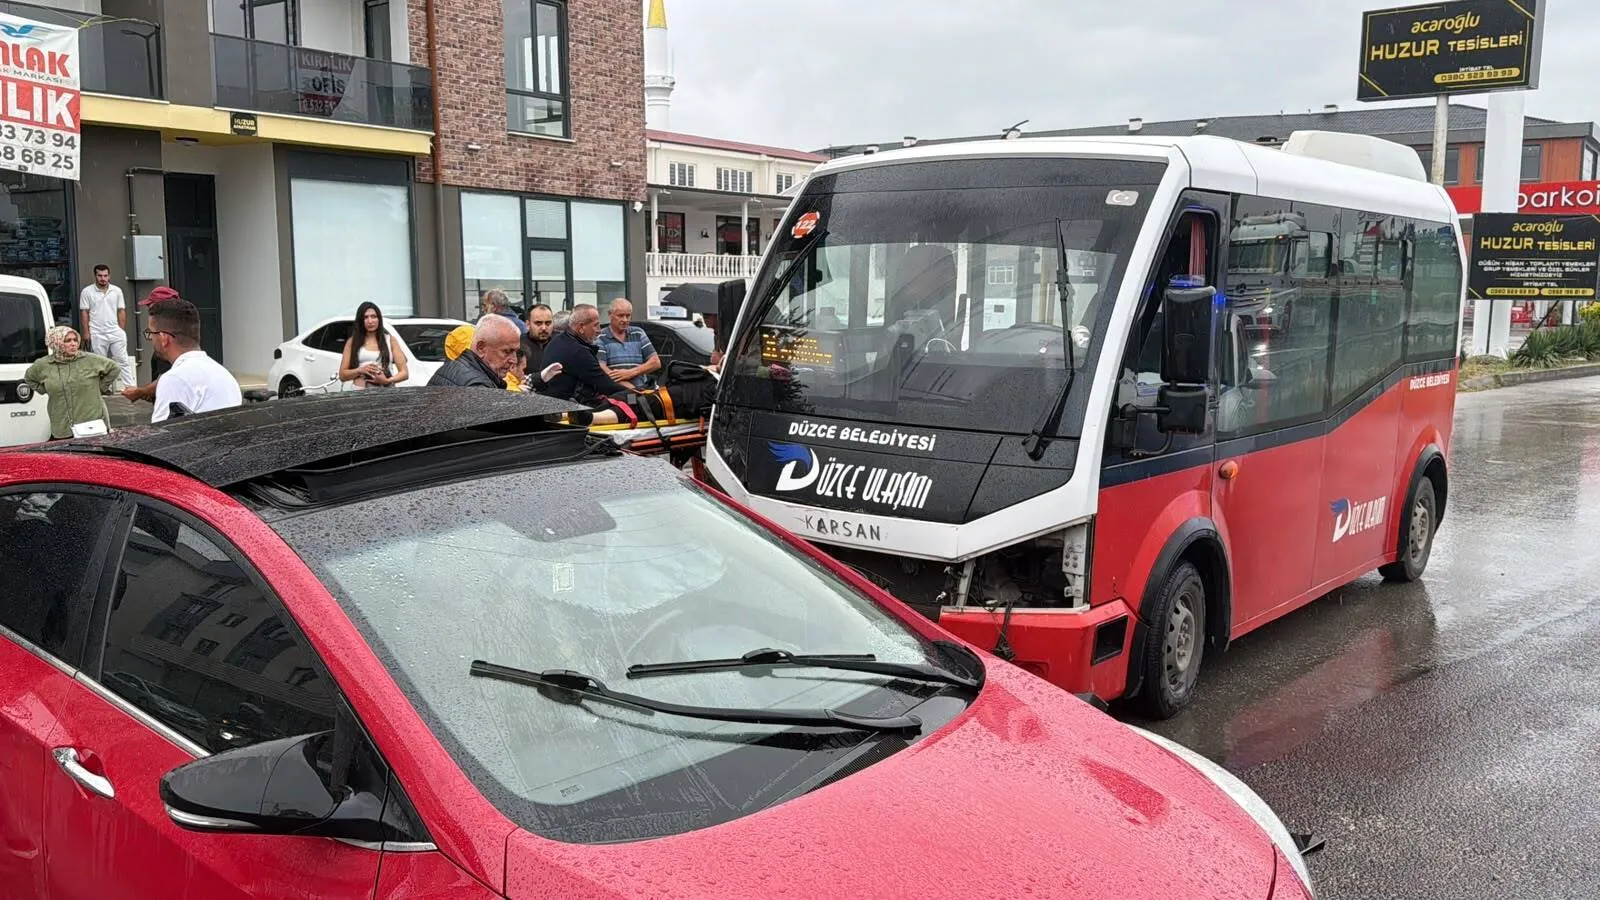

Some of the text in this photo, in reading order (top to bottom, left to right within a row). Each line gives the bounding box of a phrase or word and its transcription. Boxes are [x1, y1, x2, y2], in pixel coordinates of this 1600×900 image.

[1411, 11, 1481, 34] acaroğlu
[1370, 30, 1523, 61] HUZUR TESİSLERİ
[302, 52, 352, 71] KIRALIK
[13, 69, 63, 83] MARKASI
[312, 74, 346, 94] OFİS
[0, 80, 75, 128] LIK
[0, 124, 76, 150] 3 73 94
[0, 146, 74, 170] 8 68 25
[1512, 220, 1564, 236] acaroğlu
[1480, 237, 1596, 251] HUZUR TESİSLERİ
[10, 410, 37, 418] DOBLO
[788, 420, 937, 451] DÜZCE BELEDİYESİ
[862, 467, 933, 511] ULAŞIM
[803, 515, 881, 541] KARSAN
